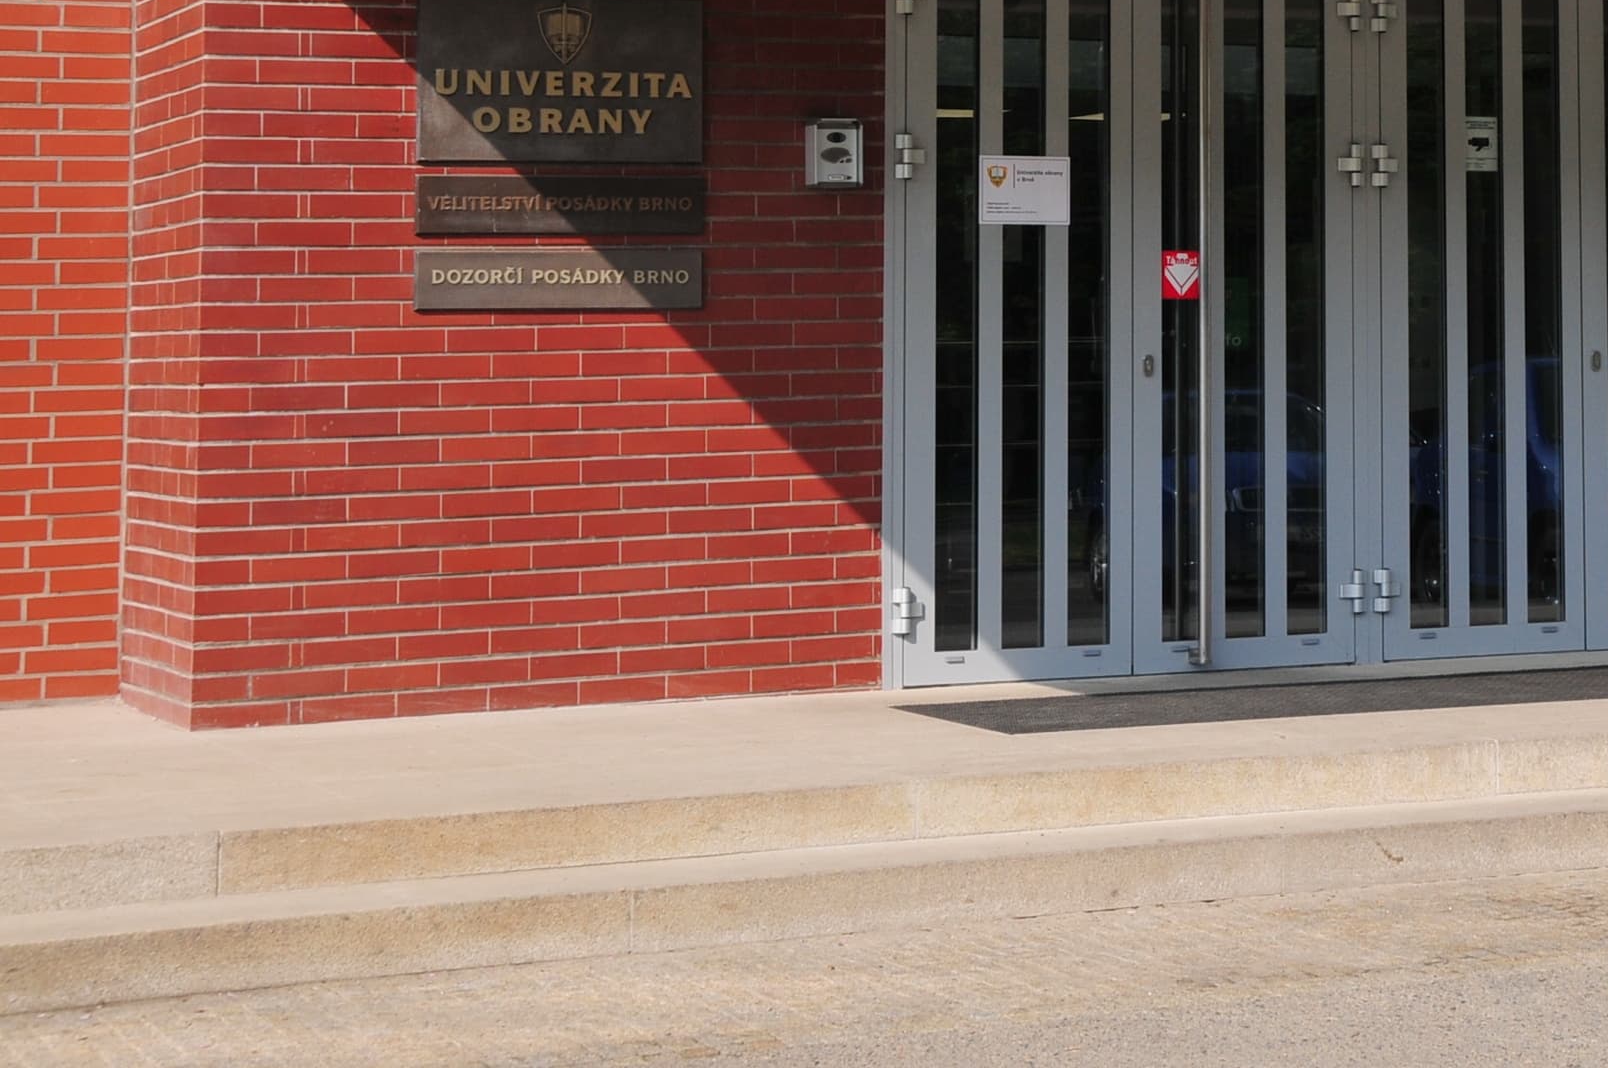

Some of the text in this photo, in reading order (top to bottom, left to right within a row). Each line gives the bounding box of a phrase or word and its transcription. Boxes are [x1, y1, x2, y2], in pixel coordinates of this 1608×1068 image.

[434, 68, 693, 99] UNIVERZITA
[472, 106, 653, 134] OBRANY
[545, 195, 634, 213] POSÁDKY
[638, 197, 693, 213] BRNO
[431, 266, 690, 285] DOZORČÍ POSÁDKY BRNO
